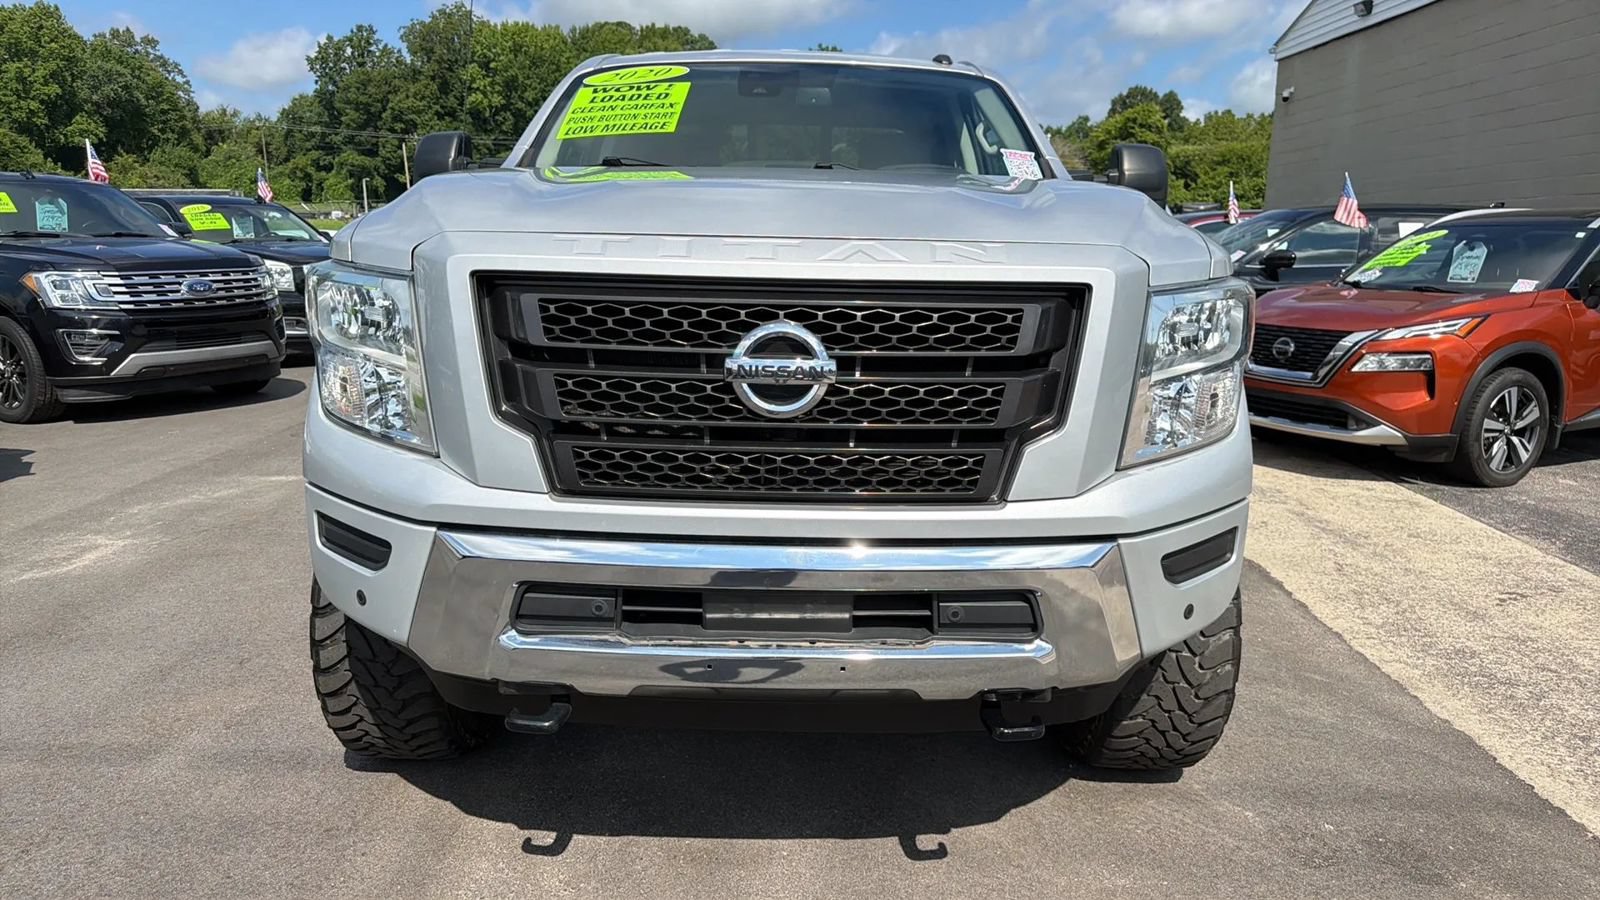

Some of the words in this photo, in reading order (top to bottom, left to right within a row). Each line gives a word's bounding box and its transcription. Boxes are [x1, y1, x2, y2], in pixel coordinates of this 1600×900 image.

[602, 67, 672, 83] 2020
[589, 92, 670, 104] LOADED
[571, 104, 618, 115] CLEAN
[620, 102, 679, 112] CARFAX
[566, 115, 595, 125] PUSH
[598, 113, 640, 123] BUTTON
[641, 111, 676, 121] START
[564, 124, 598, 136] LOW
[600, 121, 671, 134] MILEAGE
[551, 233, 1008, 263] TITAN
[736, 364, 824, 381] NISSAN
